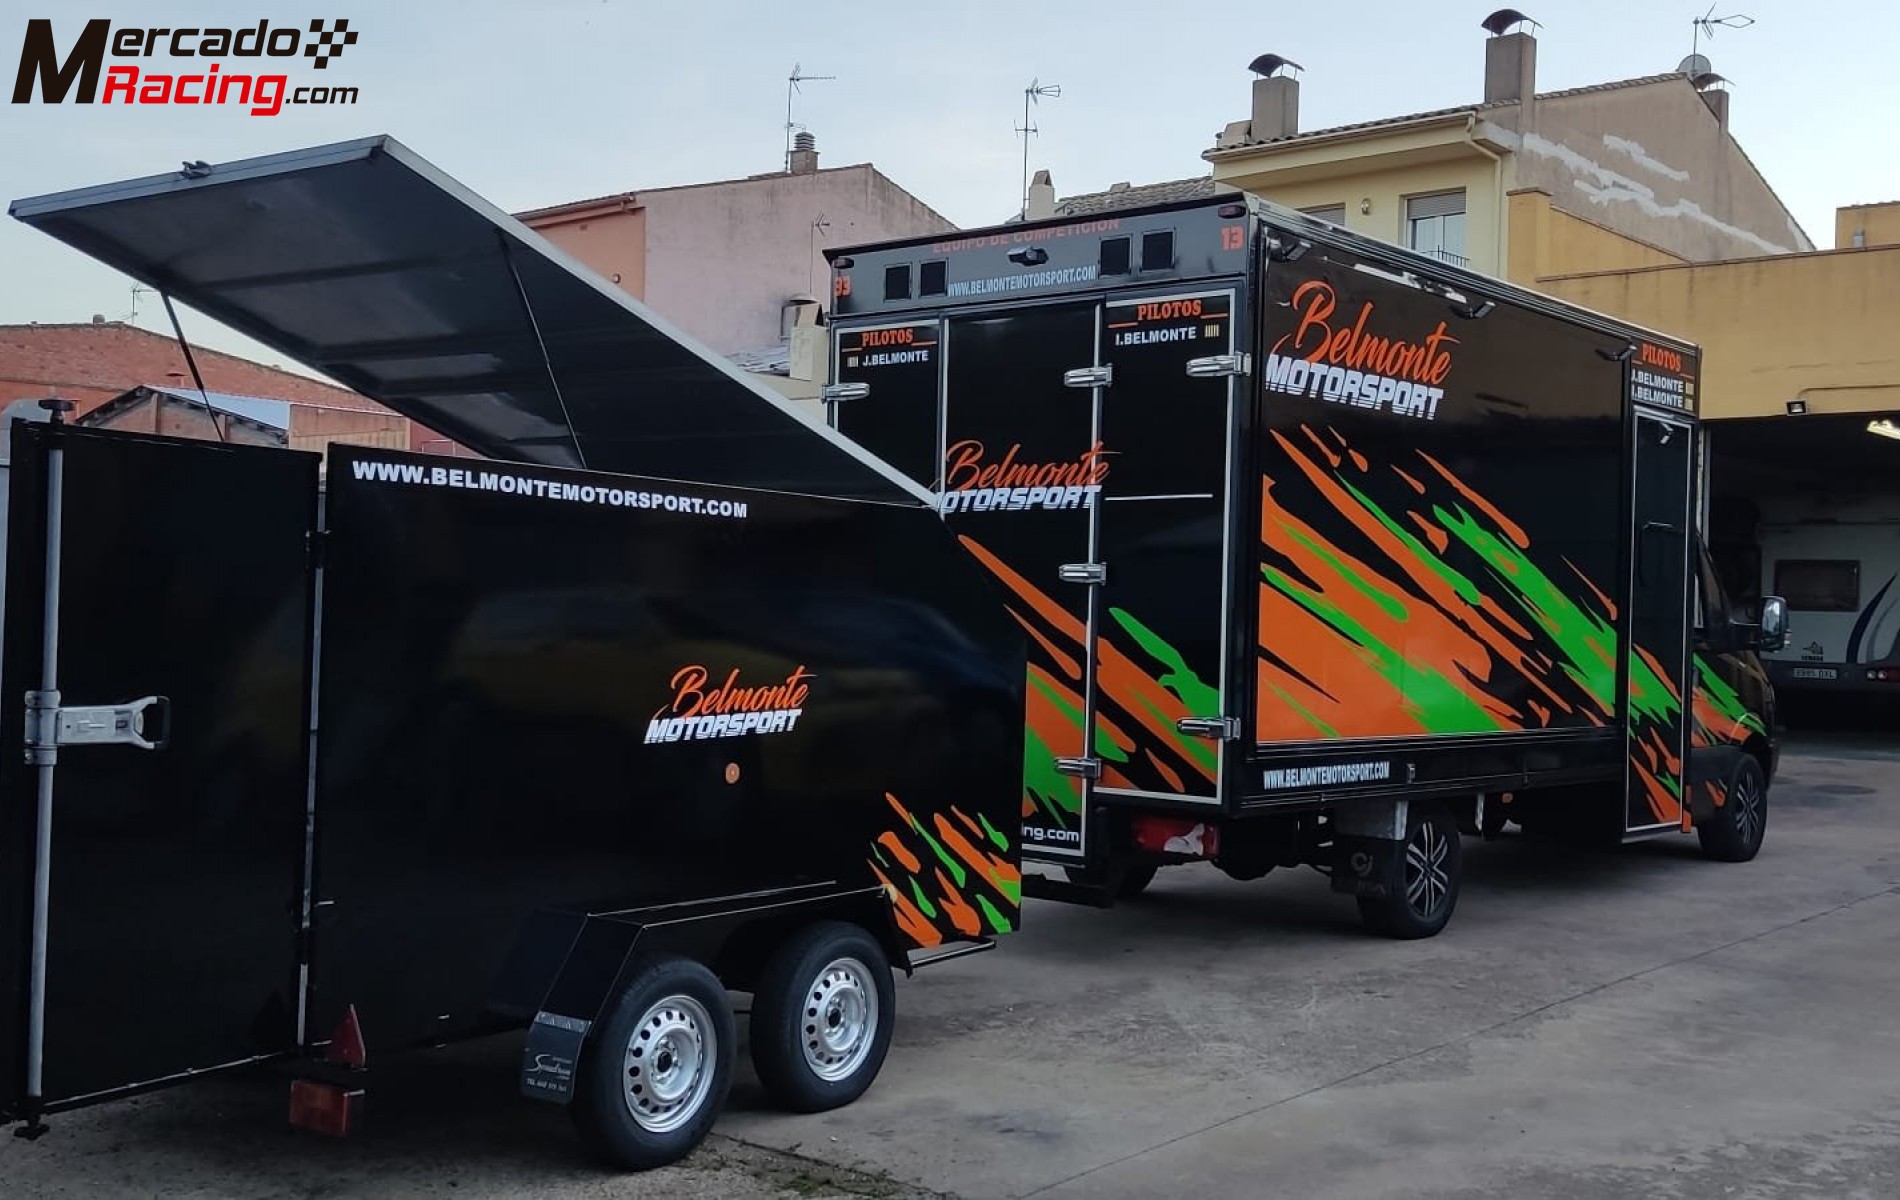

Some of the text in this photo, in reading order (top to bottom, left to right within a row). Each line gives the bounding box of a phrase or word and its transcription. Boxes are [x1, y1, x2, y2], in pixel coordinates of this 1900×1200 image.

[1221, 226, 1244, 250] 13
[948, 265, 1097, 296] WWW.BELMONTEMOTORSPORT.COM
[1137, 300, 1202, 320] PILOTOS
[862, 328, 914, 347] PILOTOS
[1115, 326, 1197, 345] I.BELMONTE
[1272, 280, 1461, 384] Belmonte
[862, 350, 929, 366] J.BELMONTE
[1642, 343, 1682, 372] PILOTOS
[1266, 354, 1444, 420] MOTORSPORT
[944, 440, 1122, 492] Belmonte
[352, 460, 748, 519] WWW.BELMONTEMOTORSPORT.COM
[936, 485, 1102, 514] OTORSPORT
[653, 665, 817, 718] Belmonte
[643, 708, 803, 744] MOTORSPORT
[1263, 761, 1390, 790] WWW.BELMONTEMOTORSPORT.COM
